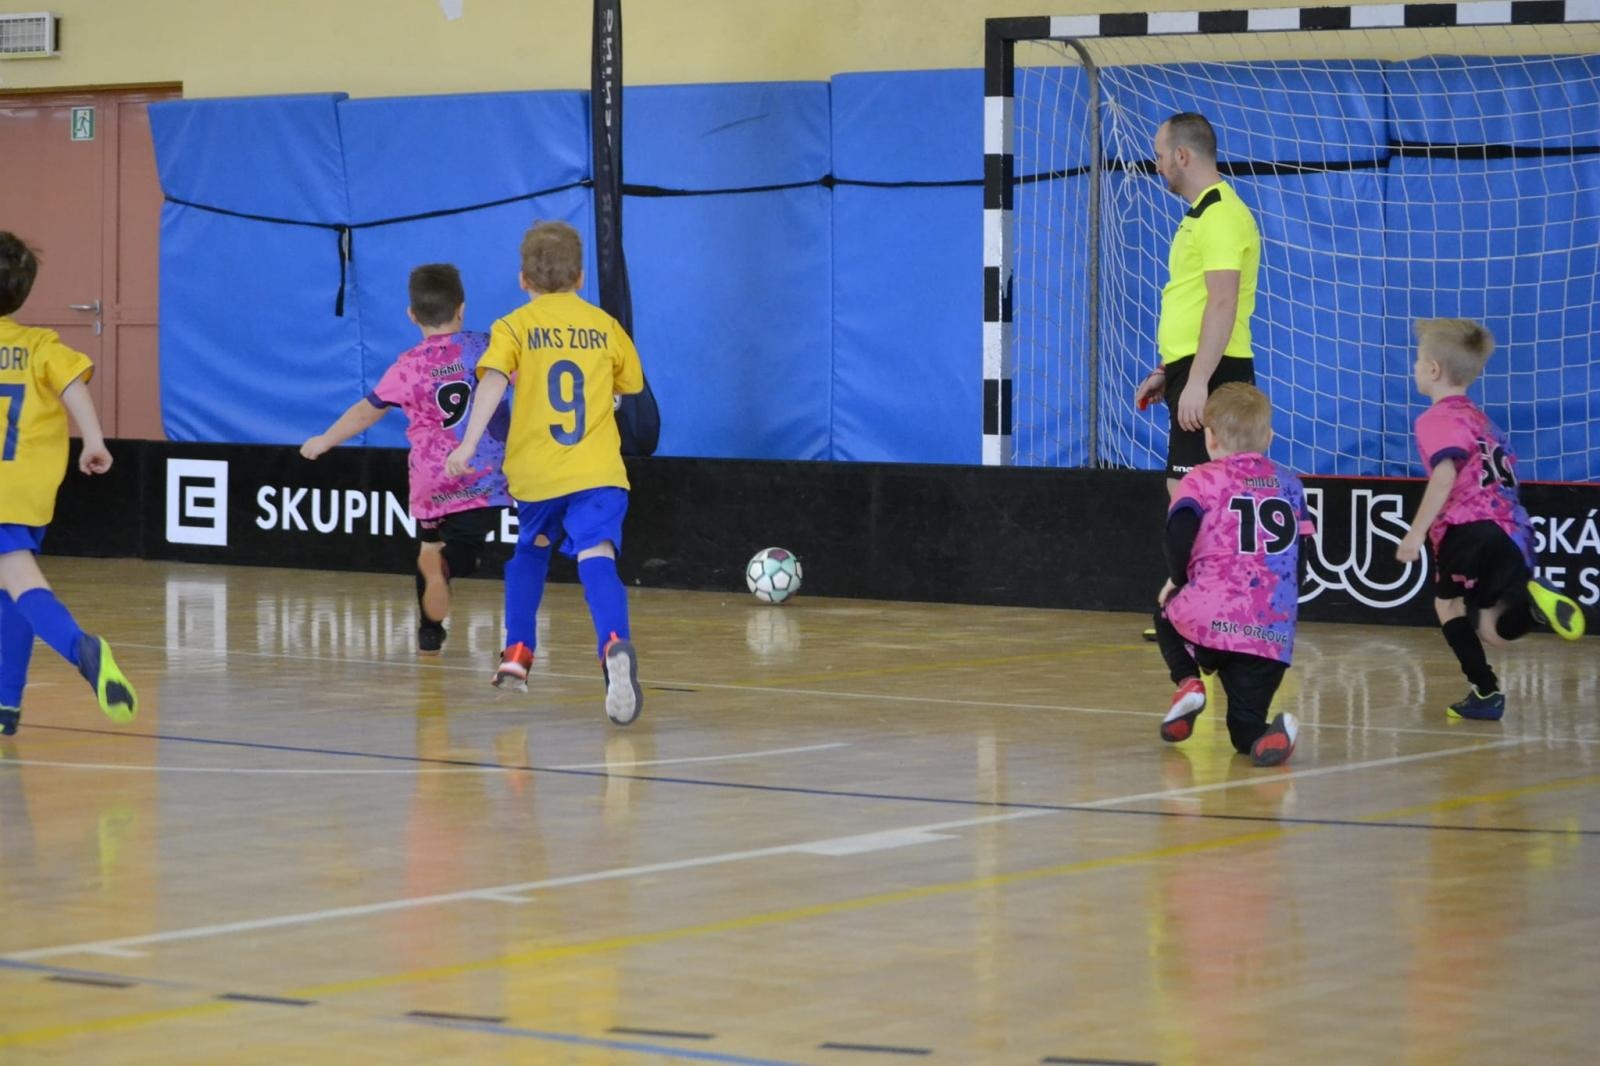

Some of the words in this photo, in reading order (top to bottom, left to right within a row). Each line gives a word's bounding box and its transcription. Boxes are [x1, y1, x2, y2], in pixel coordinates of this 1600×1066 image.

[528, 327, 564, 350] MKS
[567, 325, 608, 350] ŻORY
[0, 383, 26, 461] 7
[435, 380, 472, 431] 9
[548, 359, 586, 446] 9
[1229, 496, 1298, 555] 19
[1297, 488, 1428, 609] US
